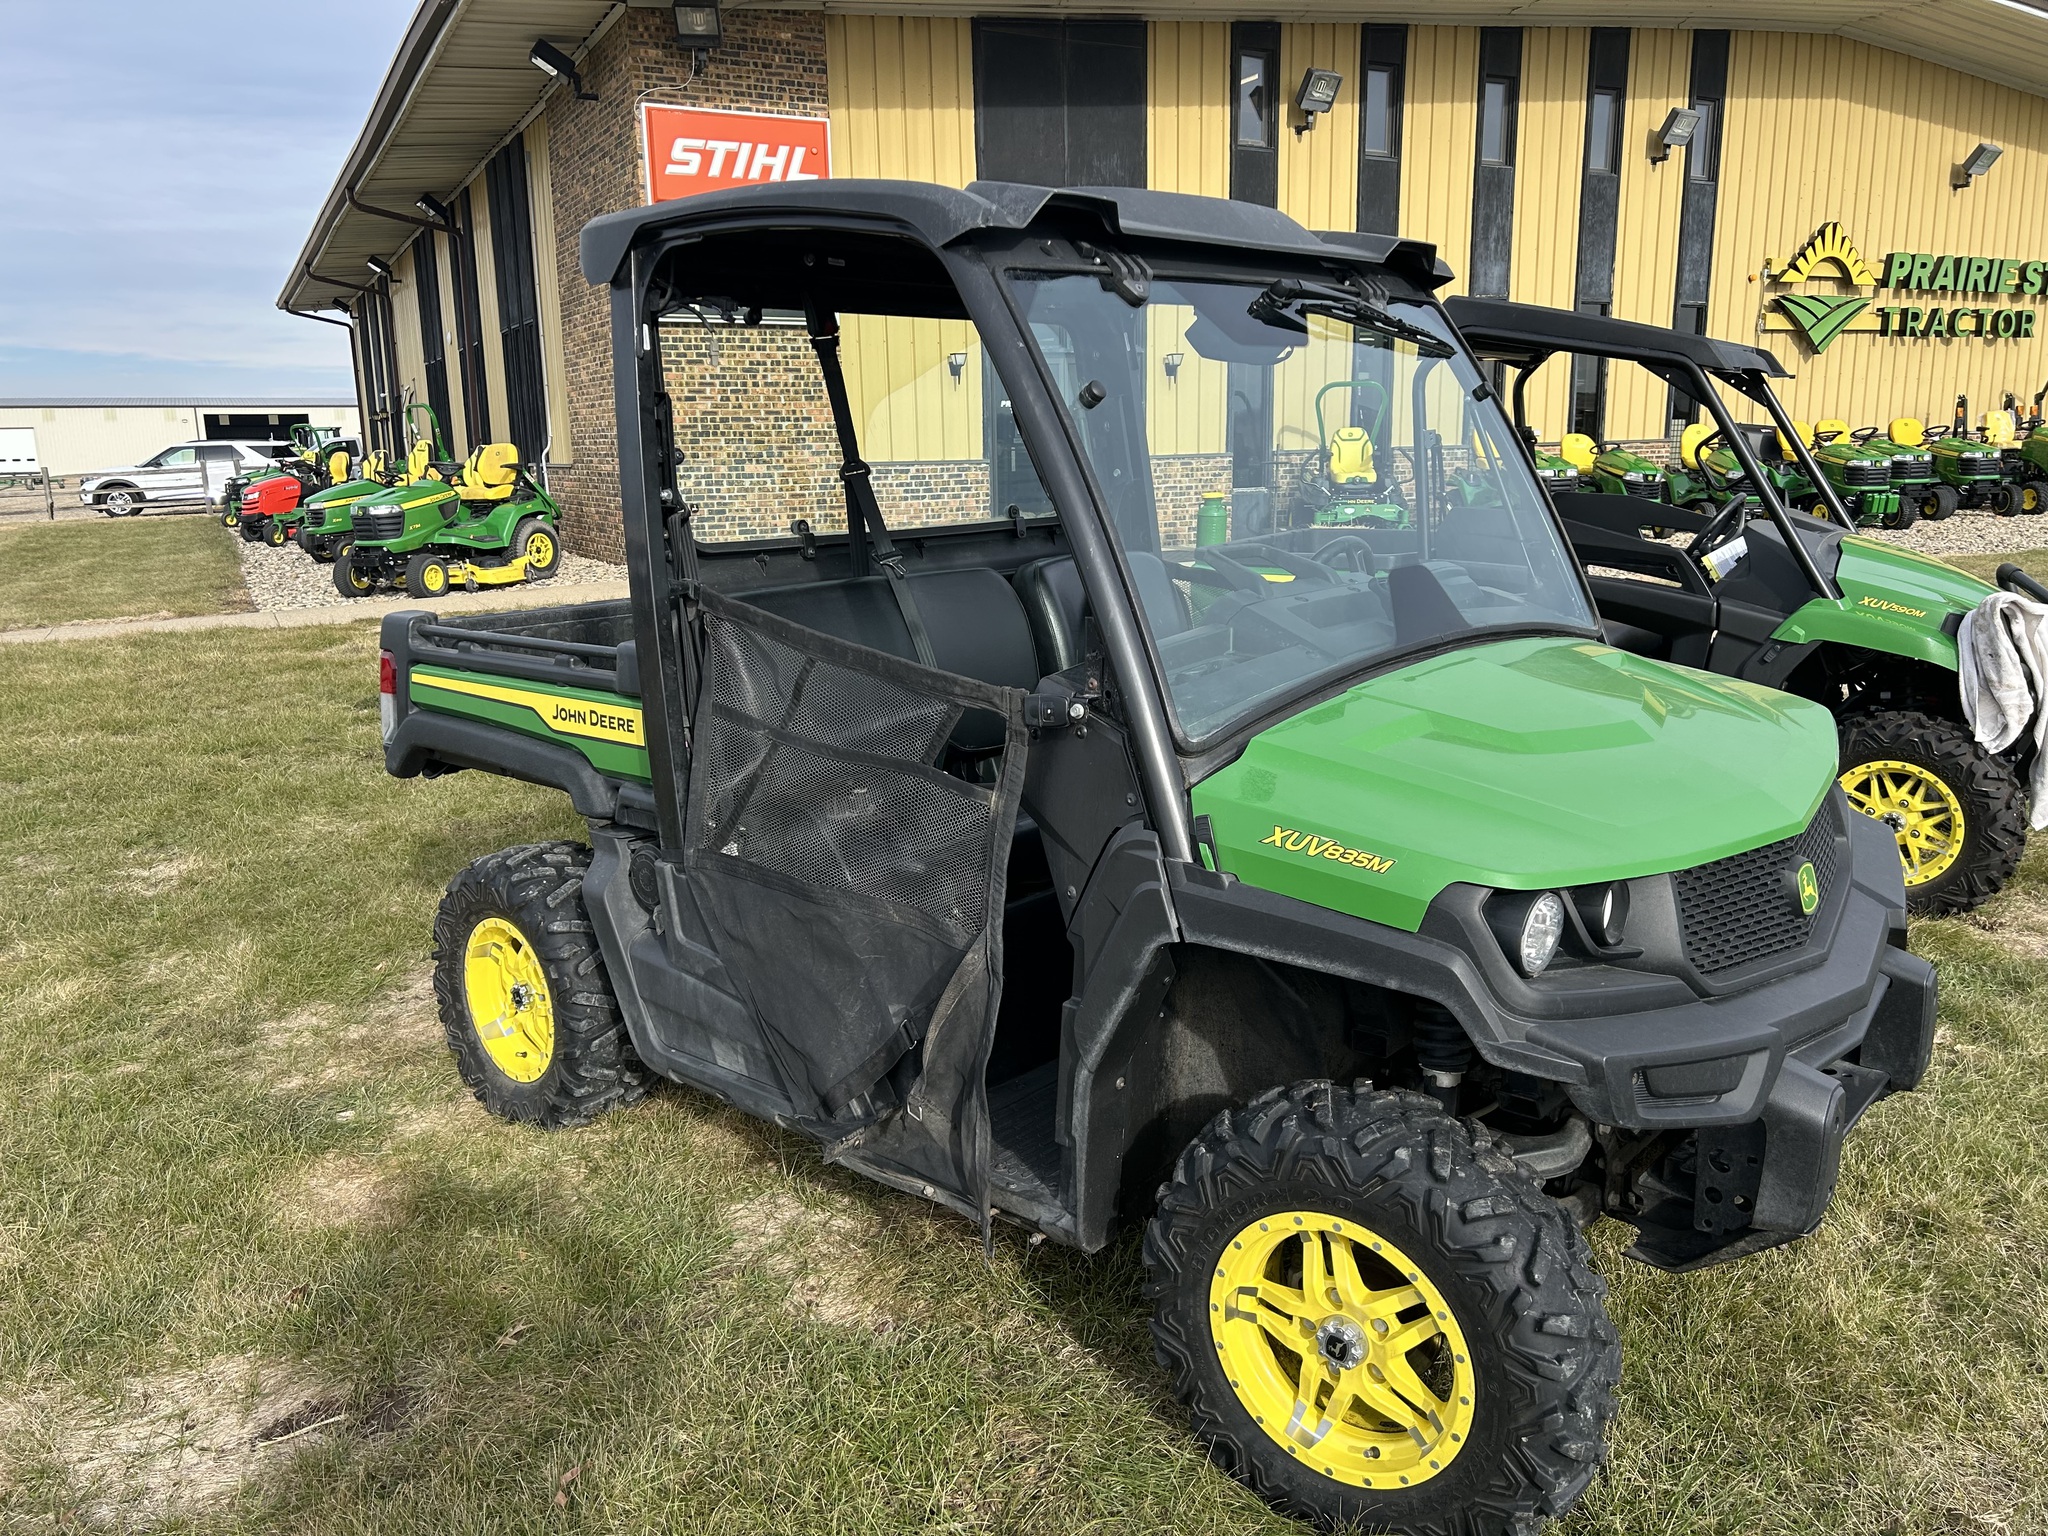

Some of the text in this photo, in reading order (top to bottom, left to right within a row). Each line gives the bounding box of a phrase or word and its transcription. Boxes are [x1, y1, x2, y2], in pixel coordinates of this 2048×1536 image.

[664, 137, 820, 181] STIHL
[1882, 252, 2021, 294] PRAIRIE
[1878, 306, 2036, 338] TRACTOR
[1858, 596, 1926, 618] XUV590M
[552, 704, 635, 734] JOHN DEERE
[1258, 825, 1398, 875] XUV835M
[1188, 1185, 1292, 1272] BIGHORN
